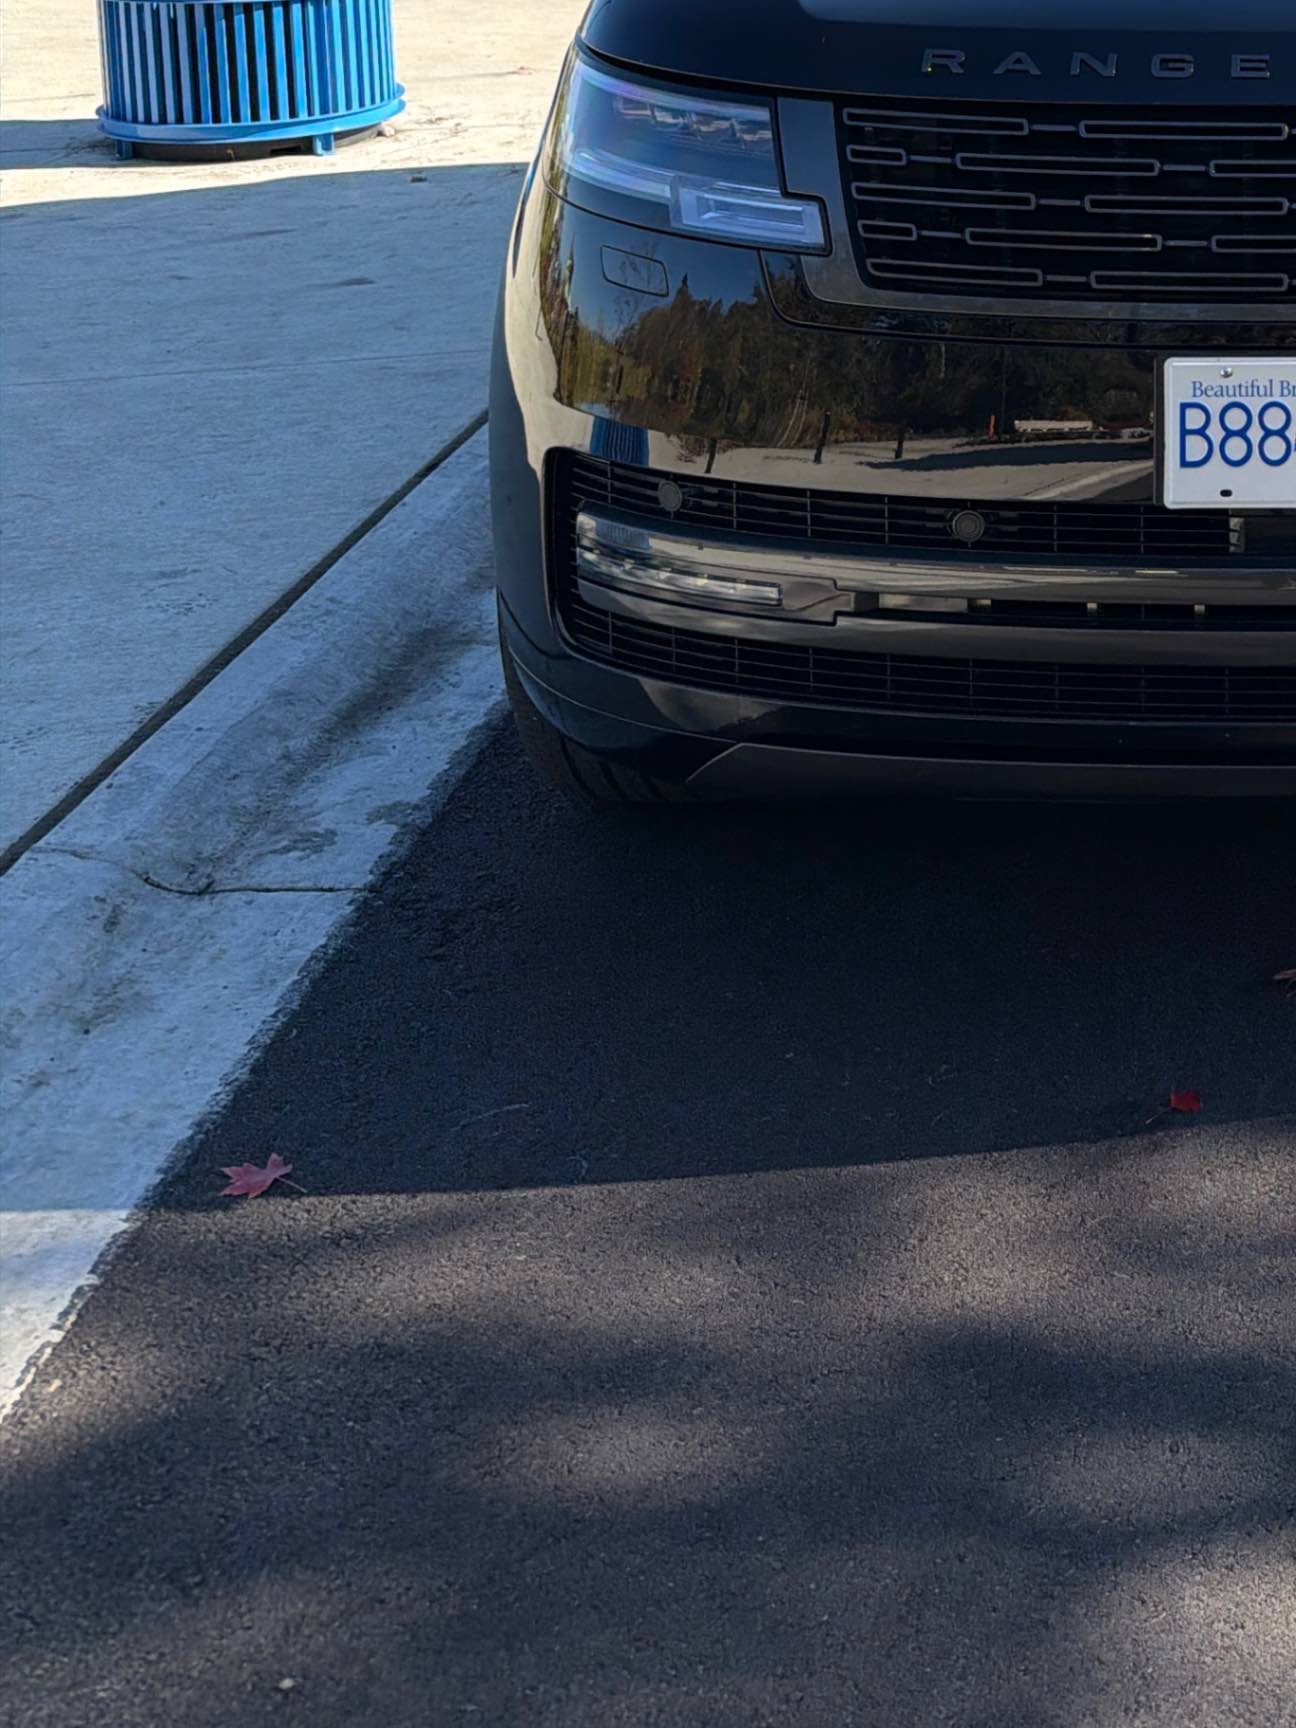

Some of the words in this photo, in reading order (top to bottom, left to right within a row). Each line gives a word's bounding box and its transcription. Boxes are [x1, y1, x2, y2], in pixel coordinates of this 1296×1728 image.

[921, 48, 1271, 79] RANGE
[1191, 379, 1274, 397] Beautiful
[1179, 401, 1292, 467] B88
